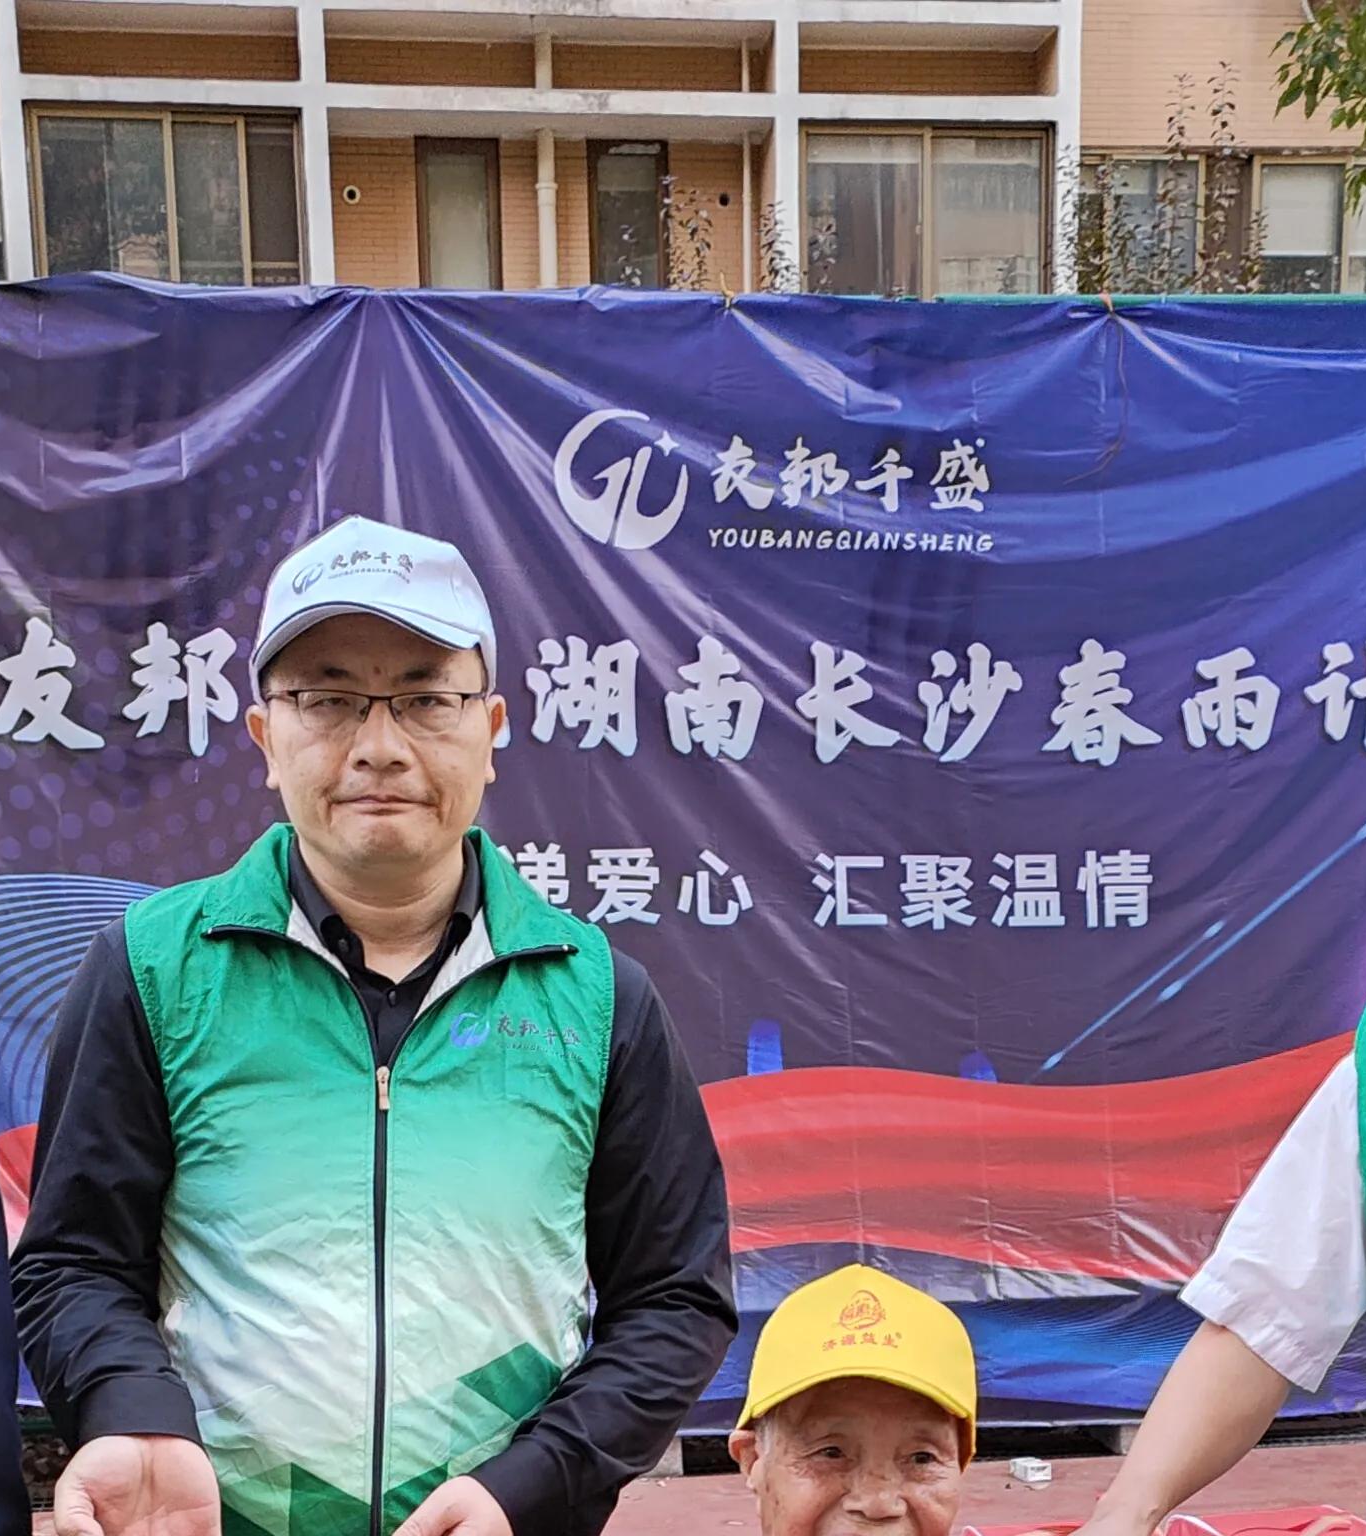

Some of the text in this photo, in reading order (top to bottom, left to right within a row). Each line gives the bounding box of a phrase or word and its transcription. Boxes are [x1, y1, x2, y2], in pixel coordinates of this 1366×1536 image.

[709, 433, 991, 513] 友邦千盛
[707, 527, 995, 554] YOUBANGQIANSHENG
[501, 842, 1154, 930] 递爱心 汇聚温情
